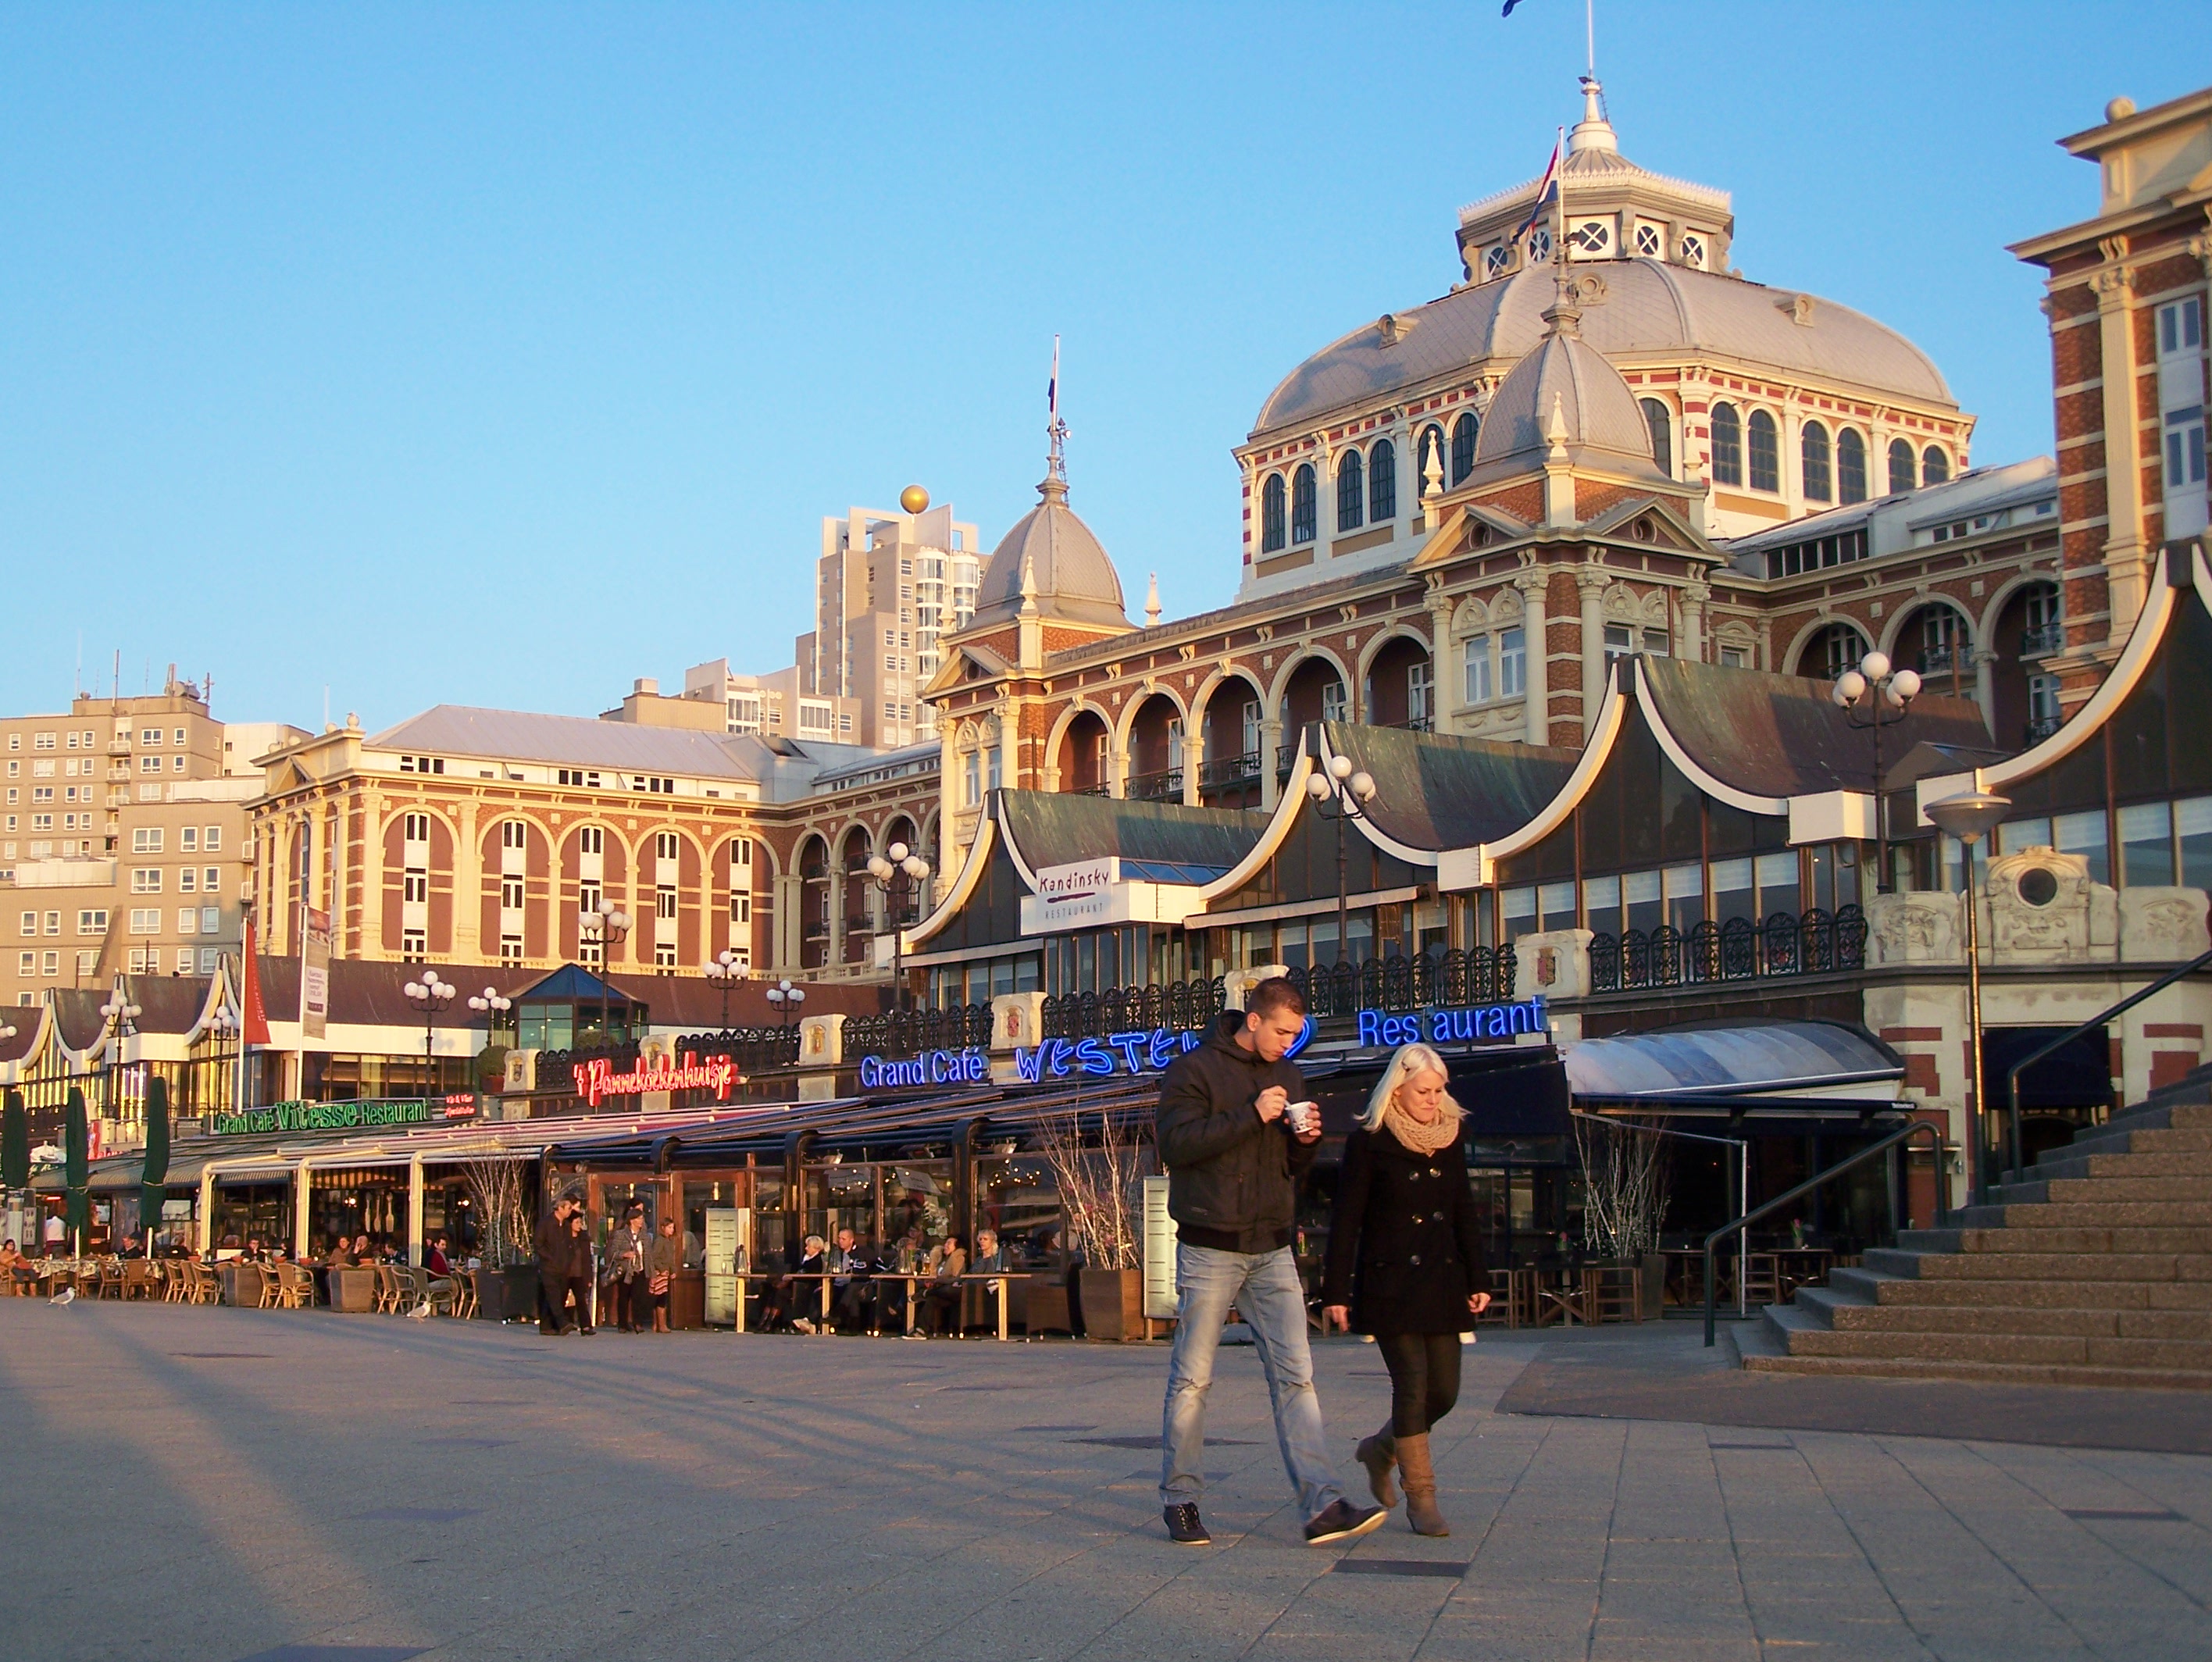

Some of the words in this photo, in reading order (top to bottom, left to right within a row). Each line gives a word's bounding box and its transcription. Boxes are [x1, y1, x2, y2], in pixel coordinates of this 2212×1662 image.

[1040, 868, 1109, 893] Kandinsky
[1045, 902, 1103, 919] RESTAURANT
[861, 1052, 926, 1087] Grand
[932, 1047, 984, 1083] Café
[1359, 995, 1545, 1047] Restaurant
[573, 1064, 586, 1097] 't
[588, 1050, 735, 1106] Pannekoekenhuisje
[218, 1114, 248, 1134] Grand
[250, 1108, 274, 1132] Café
[275, 1100, 357, 1131] Vitesse
[361, 1100, 429, 1125] Restaurant
